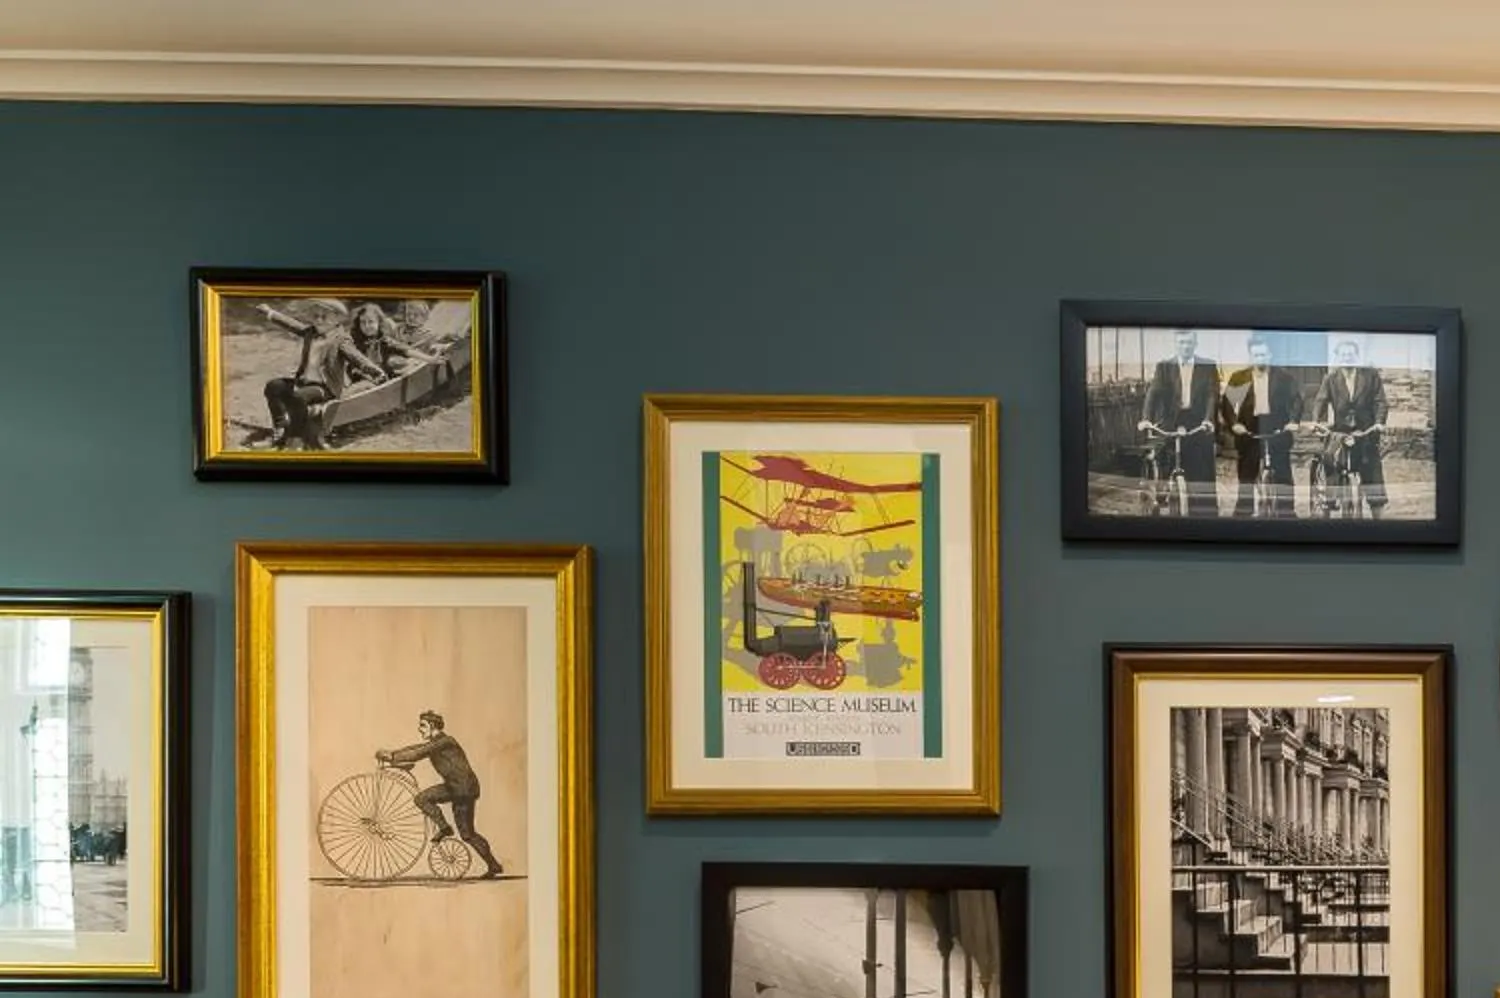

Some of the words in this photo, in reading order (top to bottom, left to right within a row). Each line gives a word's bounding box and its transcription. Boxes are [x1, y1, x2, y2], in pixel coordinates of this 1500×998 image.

[728, 697, 760, 712] THE
[765, 697, 836, 712] SCIENCE
[841, 697, 917, 713] MUSEUM
[745, 721, 797, 736] SOUTH
